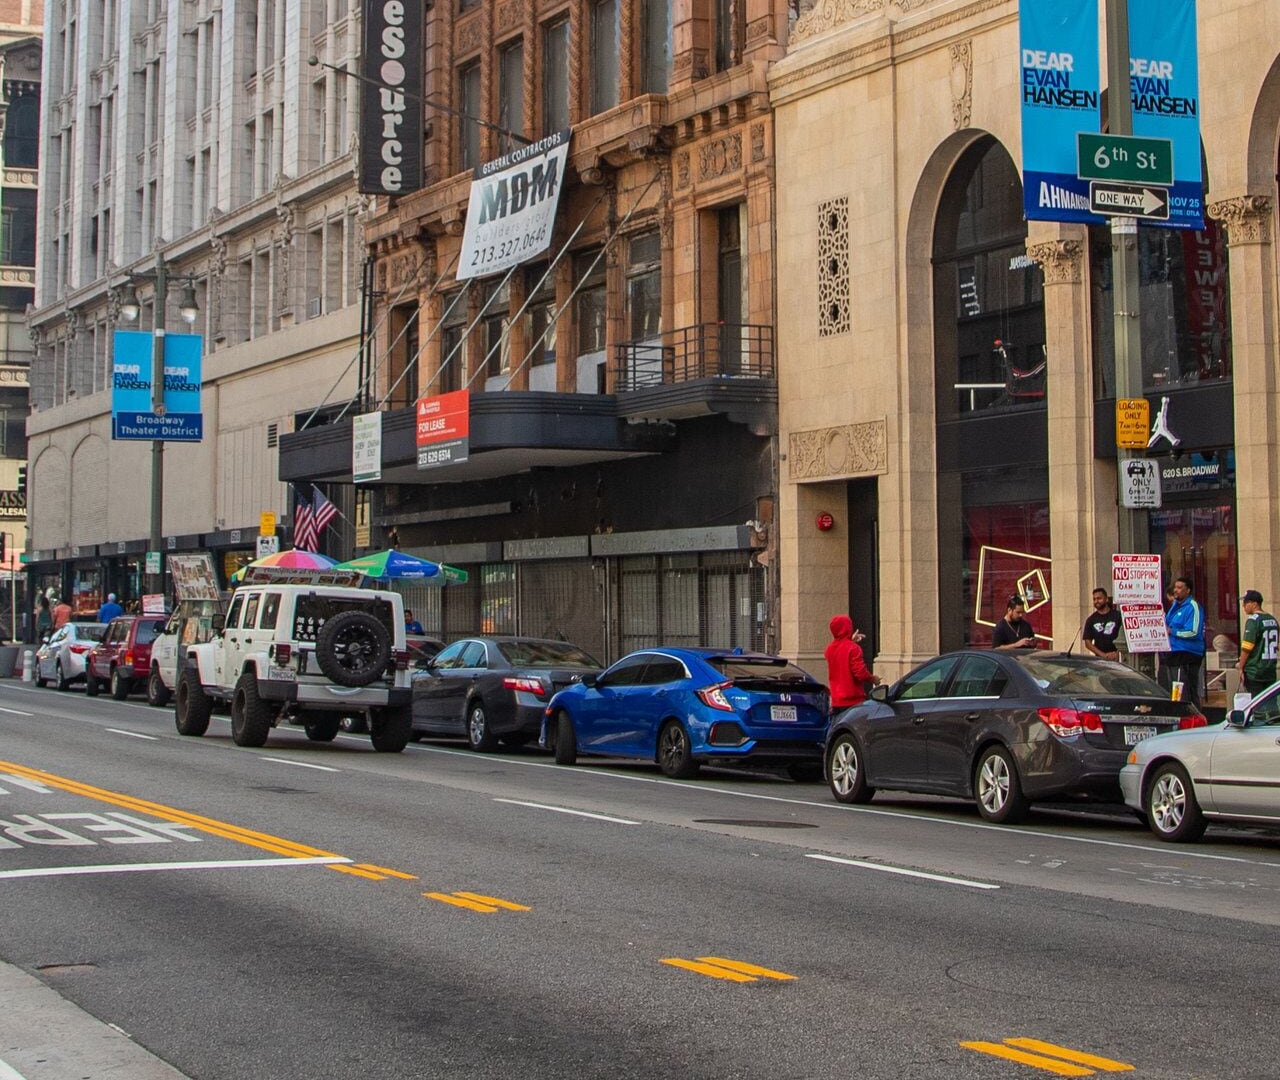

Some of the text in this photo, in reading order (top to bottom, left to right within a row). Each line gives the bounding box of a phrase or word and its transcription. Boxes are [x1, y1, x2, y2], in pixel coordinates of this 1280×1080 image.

[1023, 49, 1073, 72] DEAR
[1023, 70, 1069, 88] EVAN
[1024, 86, 1097, 108] HANSEN
[482, 131, 562, 175] GENERAL CONTRACTORS
[1094, 146, 1157, 170] 6th St
[478, 155, 560, 225] MDM
[1099, 193, 1145, 205] ONE WAY
[1188, 198, 1200, 208] 25
[471, 223, 547, 267] 213.327.0646
[113, 363, 141, 373] DEAR
[163, 366, 189, 376] DEAR
[114, 372, 138, 381] EVAN
[164, 375, 187, 384] EVAN
[114, 380, 151, 390] HANSEN
[163, 383, 200, 392] HANSEN
[1119, 402, 1148, 411] LOADING
[136, 415, 185, 427] Broadway
[1124, 411, 1142, 420] ONLY
[121, 426, 199, 436] Theater District
[418, 422, 429, 433] FOR
[429, 418, 446, 431] LEASE
[1162, 468, 1176, 478] 620
[1183, 464, 1219, 477] BROADWAY
[1132, 478, 1152, 487] ONLY
[1115, 568, 1159, 580] NO STOPPING
[1118, 582, 1133, 591] 6AM
[1125, 617, 1164, 629] NO PARKING
[1262, 629, 1279, 660] 12
